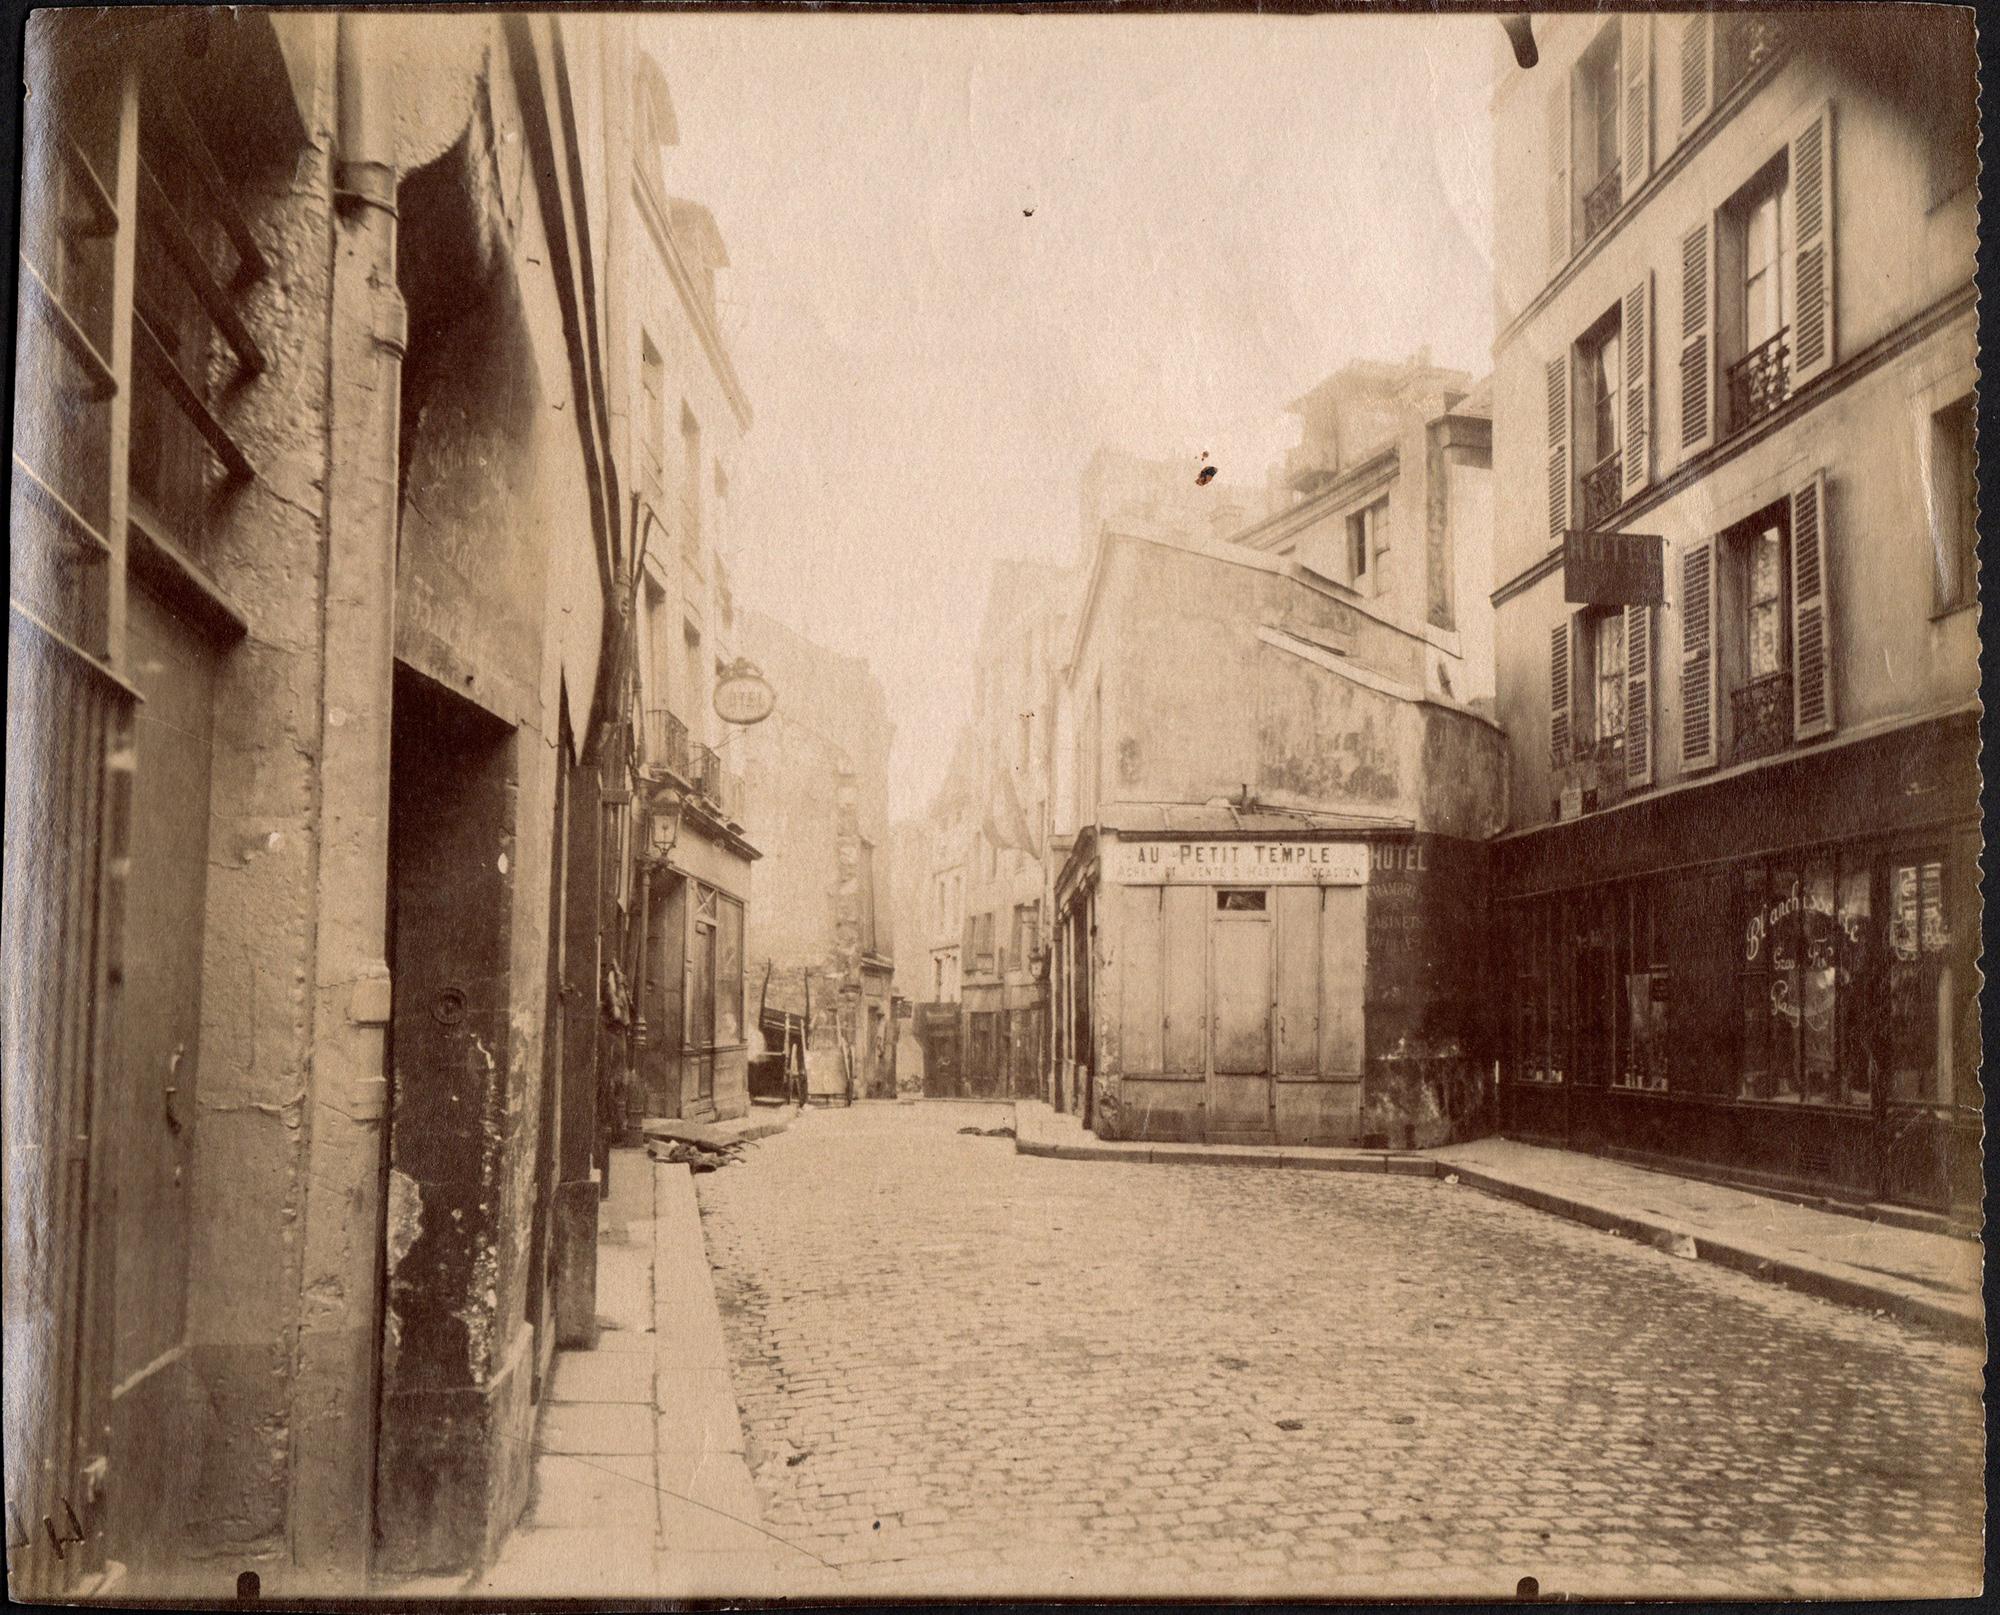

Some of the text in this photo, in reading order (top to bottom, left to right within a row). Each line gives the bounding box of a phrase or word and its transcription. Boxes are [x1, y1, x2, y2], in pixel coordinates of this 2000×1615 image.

[1138, 845, 1329, 865] AU PETIT TEMPLE
